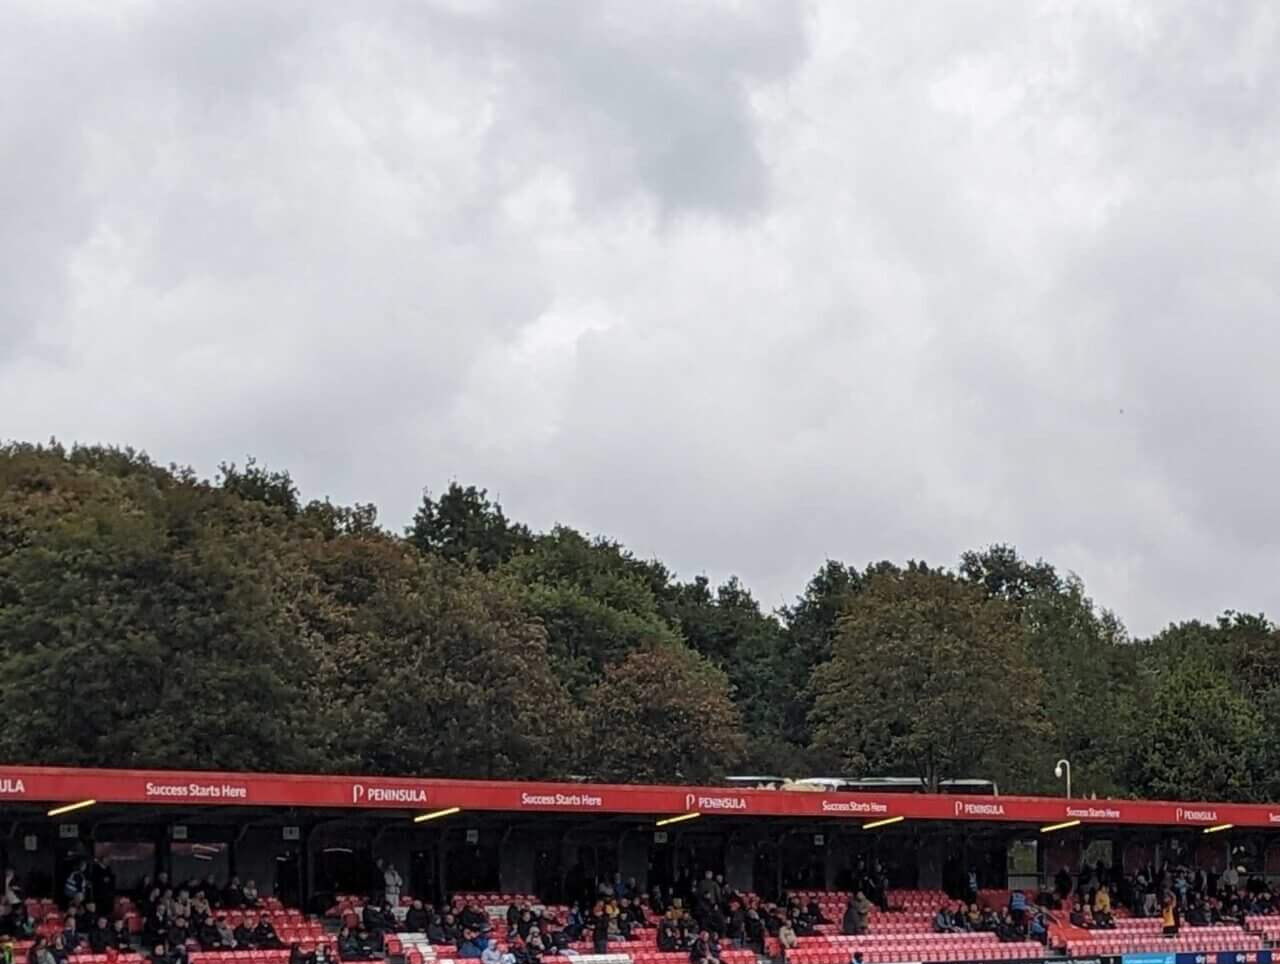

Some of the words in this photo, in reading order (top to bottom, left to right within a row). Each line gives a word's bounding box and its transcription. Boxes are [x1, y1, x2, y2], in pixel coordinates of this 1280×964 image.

[146, 783, 187, 796] Success
[189, 784, 220, 797] Starts
[222, 785, 246, 797] Here
[368, 788, 427, 802] PENINSULA
[522, 792, 554, 805] Success
[556, 793, 580, 806] Starts
[582, 794, 601, 806] Here
[699, 798, 746, 809] PENINSULA
[822, 800, 849, 811] Success
[850, 801, 870, 812] Starts
[871, 802, 887, 813] Here
[965, 804, 1004, 815] PENINSULA
